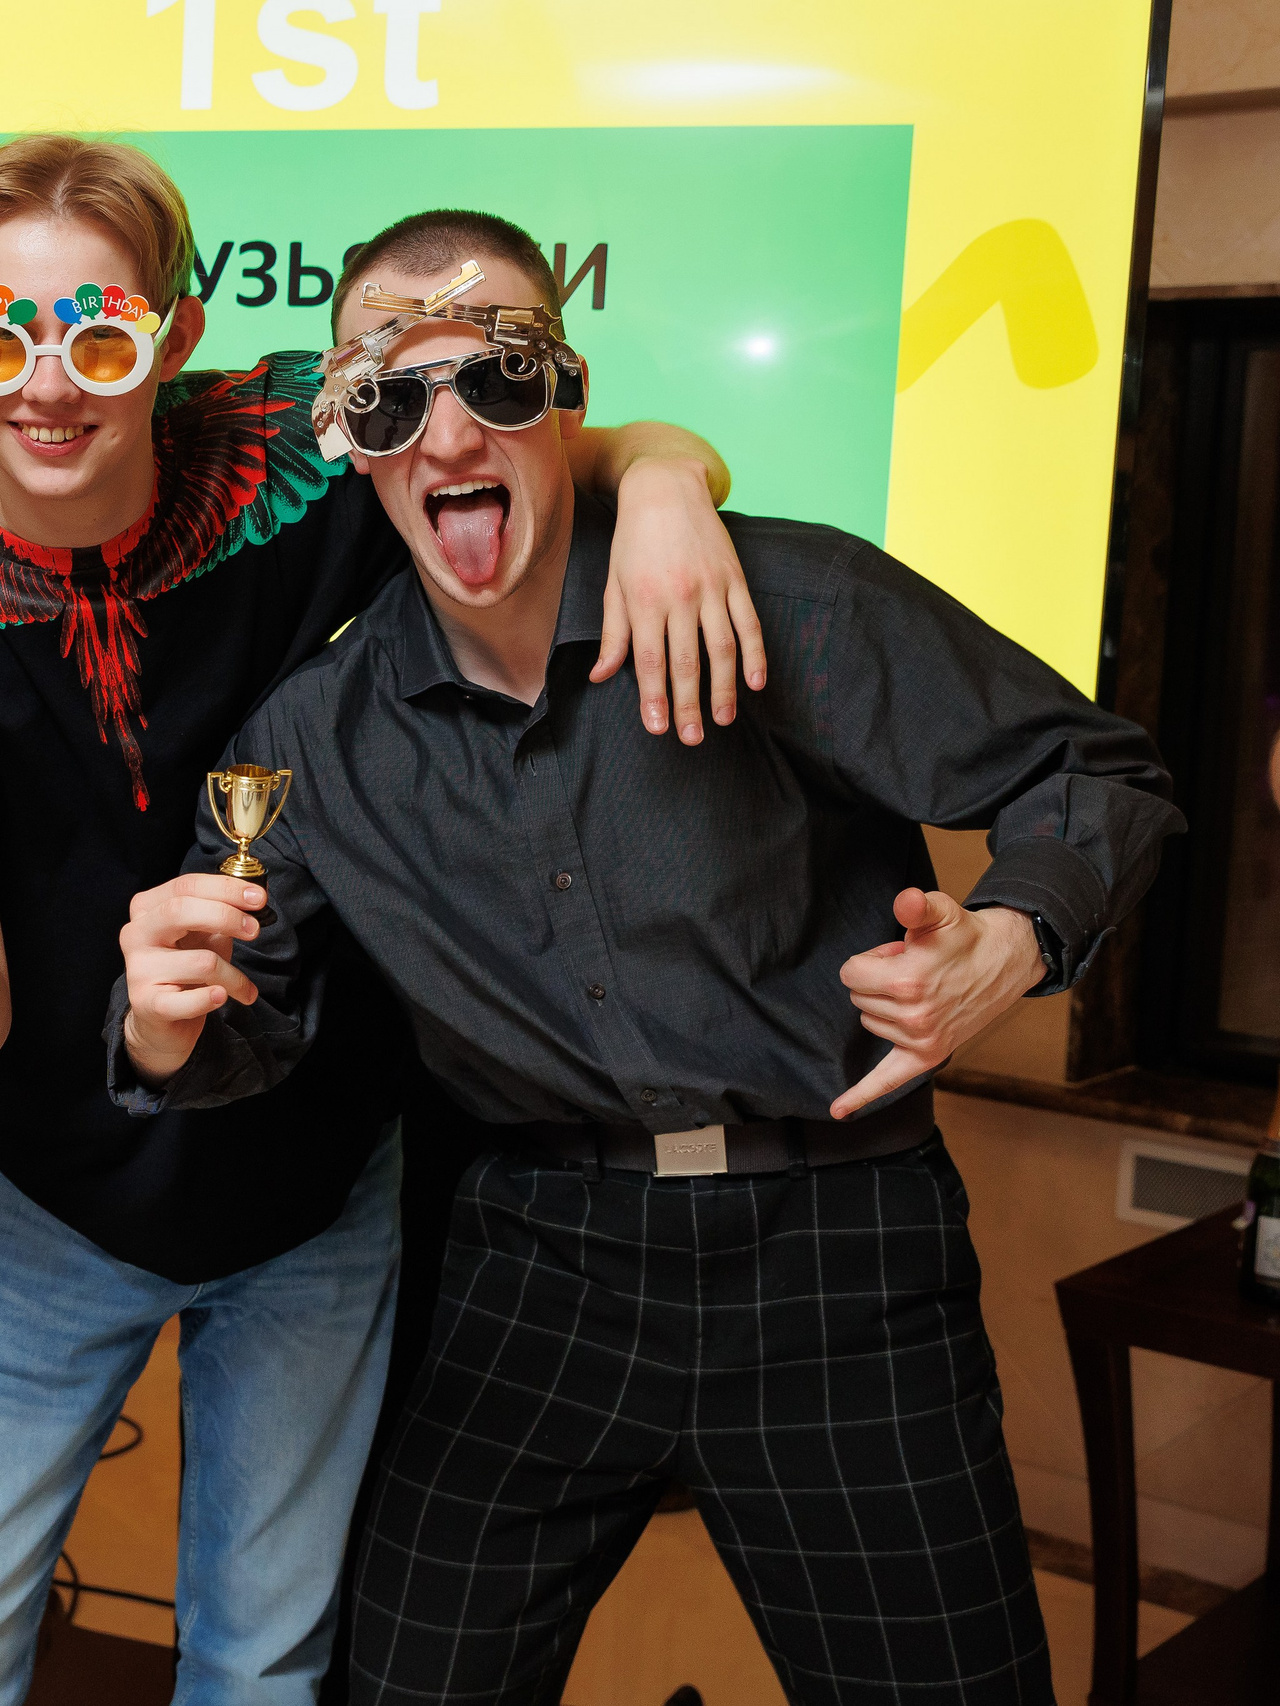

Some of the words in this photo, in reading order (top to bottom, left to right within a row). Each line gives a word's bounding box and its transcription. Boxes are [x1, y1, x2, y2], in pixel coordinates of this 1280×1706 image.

[147, 0, 440, 111] 1st
[72, 296, 146, 319] BIRTHDAY
[193, 240, 608, 310] УЗЬИ
